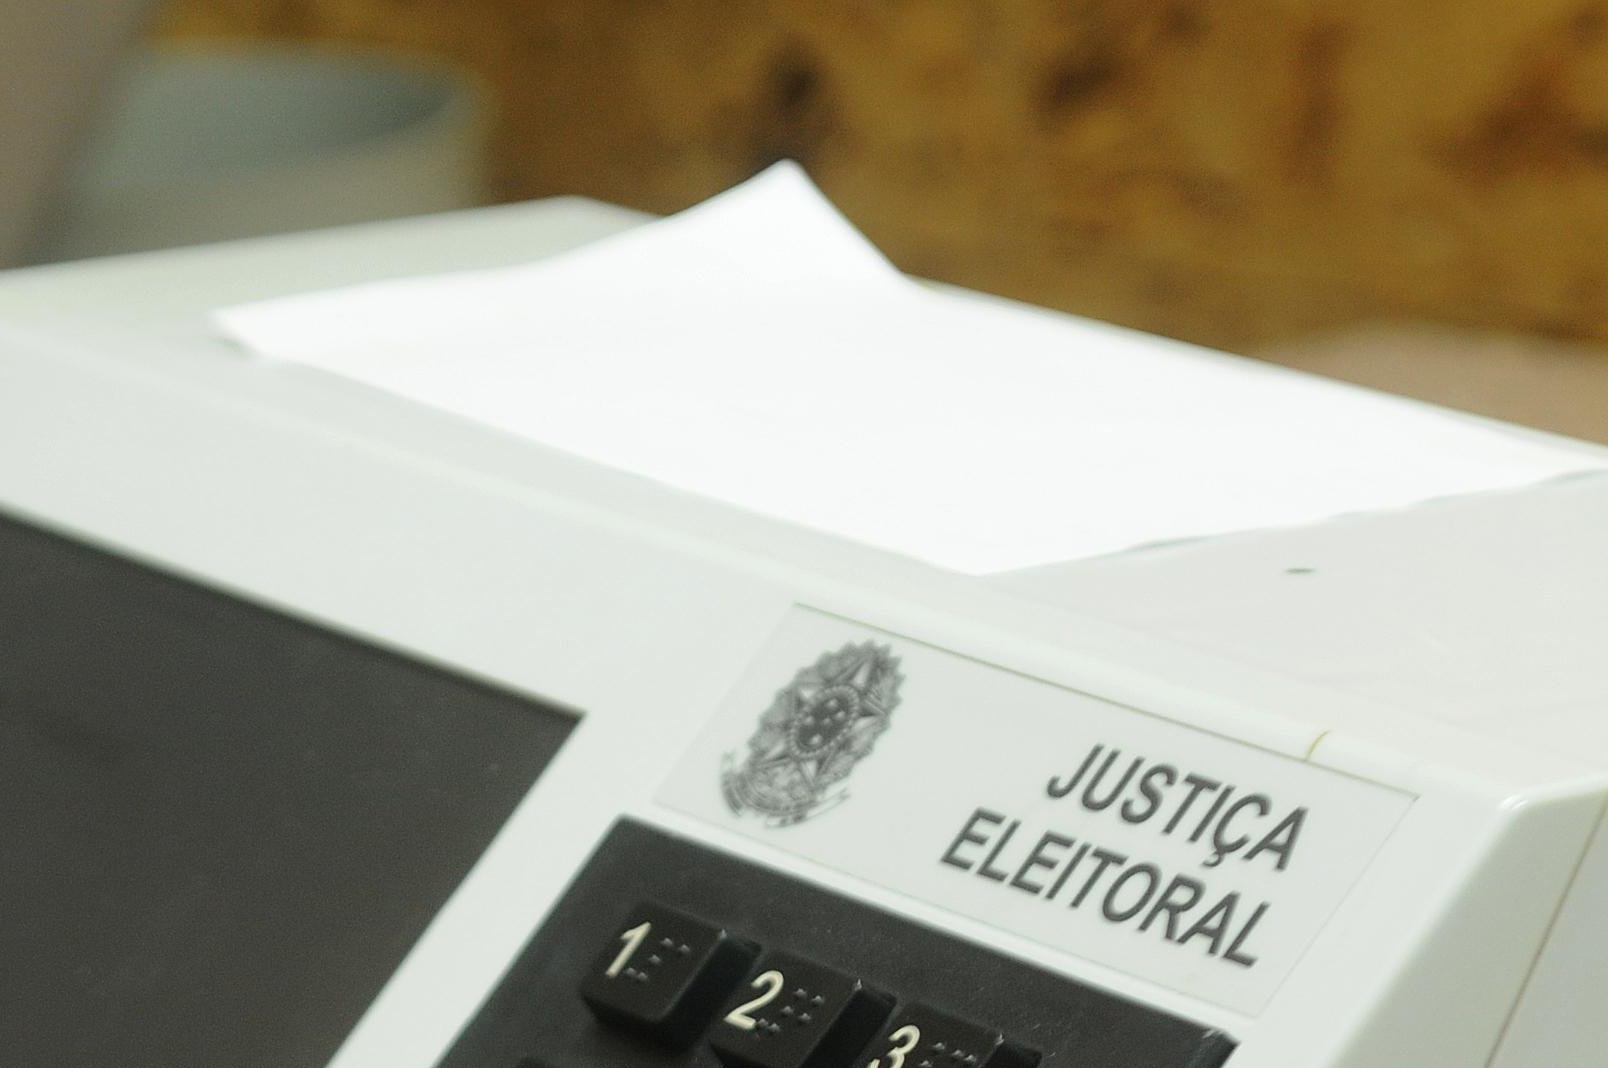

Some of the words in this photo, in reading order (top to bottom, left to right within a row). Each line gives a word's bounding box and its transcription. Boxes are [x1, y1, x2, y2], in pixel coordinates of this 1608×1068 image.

[1045, 744, 1309, 872] JUSTIÇA
[939, 807, 1270, 969] ELEITORAL
[605, 921, 652, 978] 1
[724, 970, 784, 1030] 2
